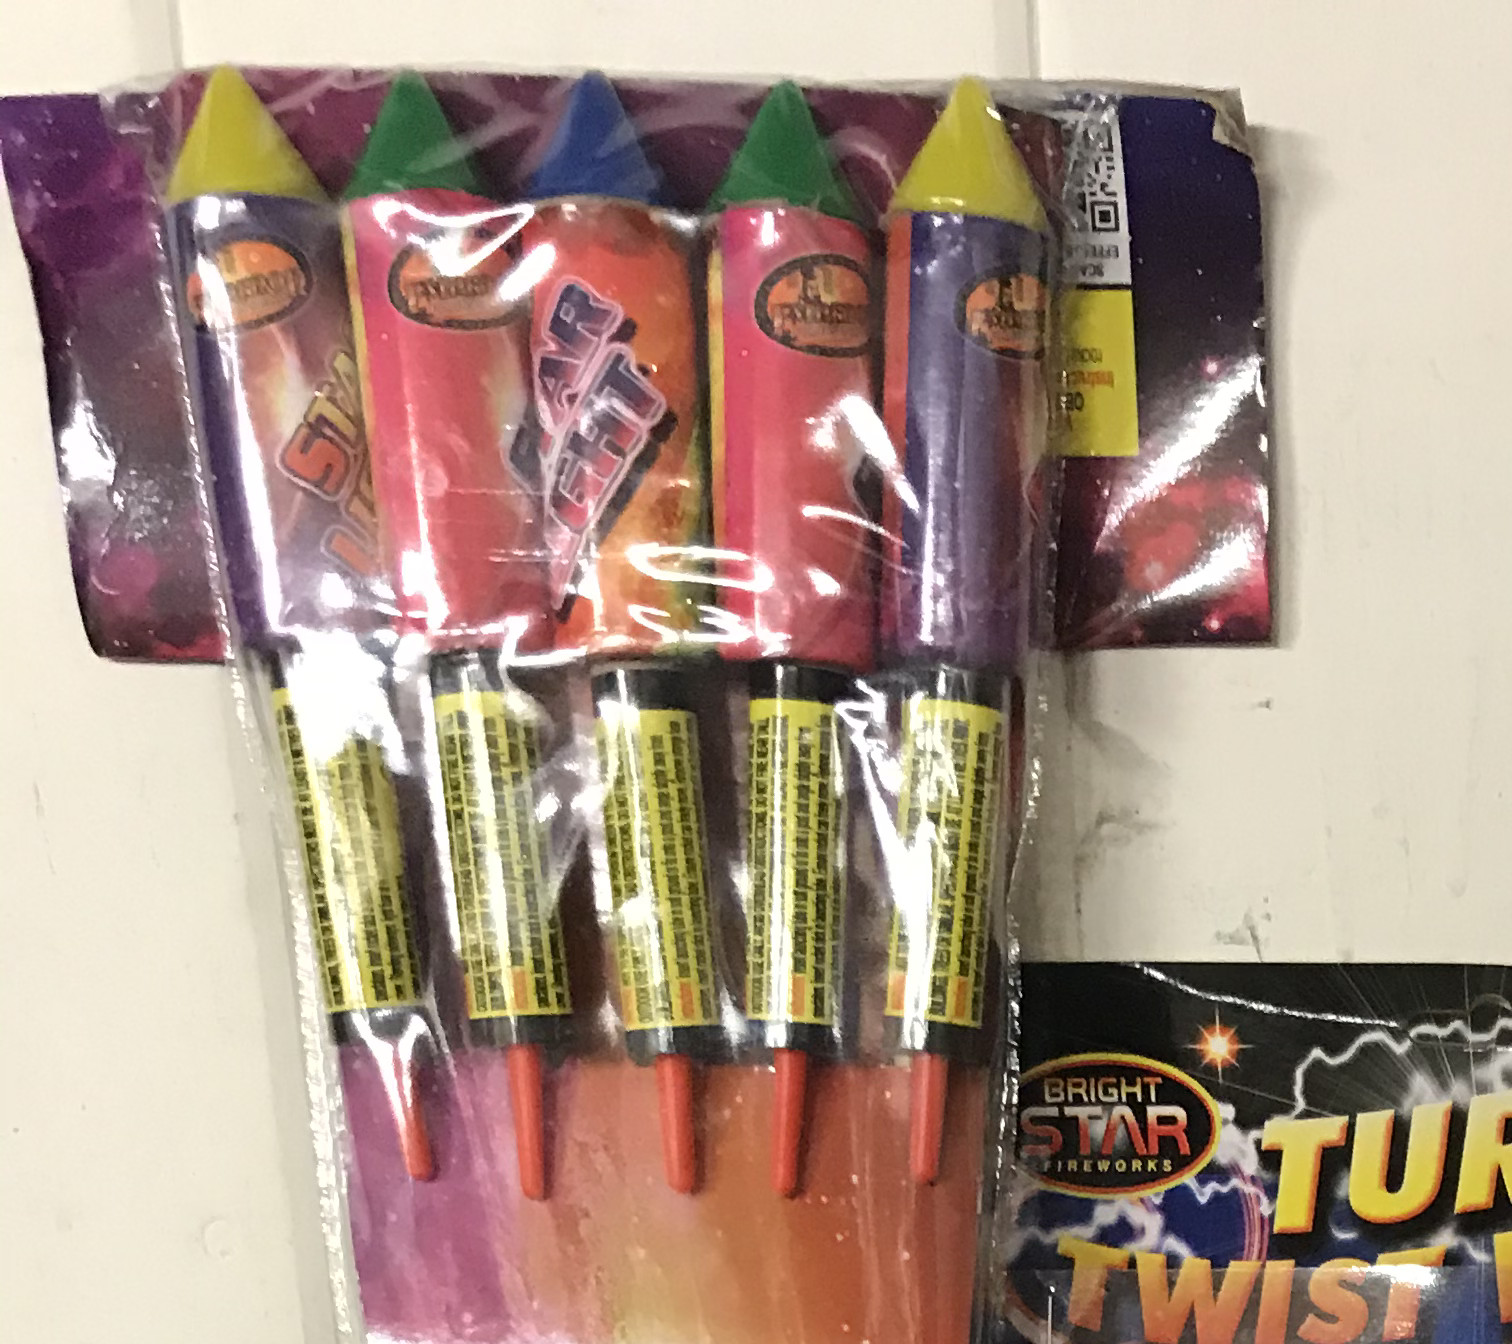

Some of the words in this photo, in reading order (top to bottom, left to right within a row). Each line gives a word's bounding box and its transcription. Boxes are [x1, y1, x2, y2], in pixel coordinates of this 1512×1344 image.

[1044, 1076, 1163, 1103] BRIGHT
[1020, 1107, 1190, 1156] STAR
[1043, 1158, 1173, 1174] FIREWORKS
